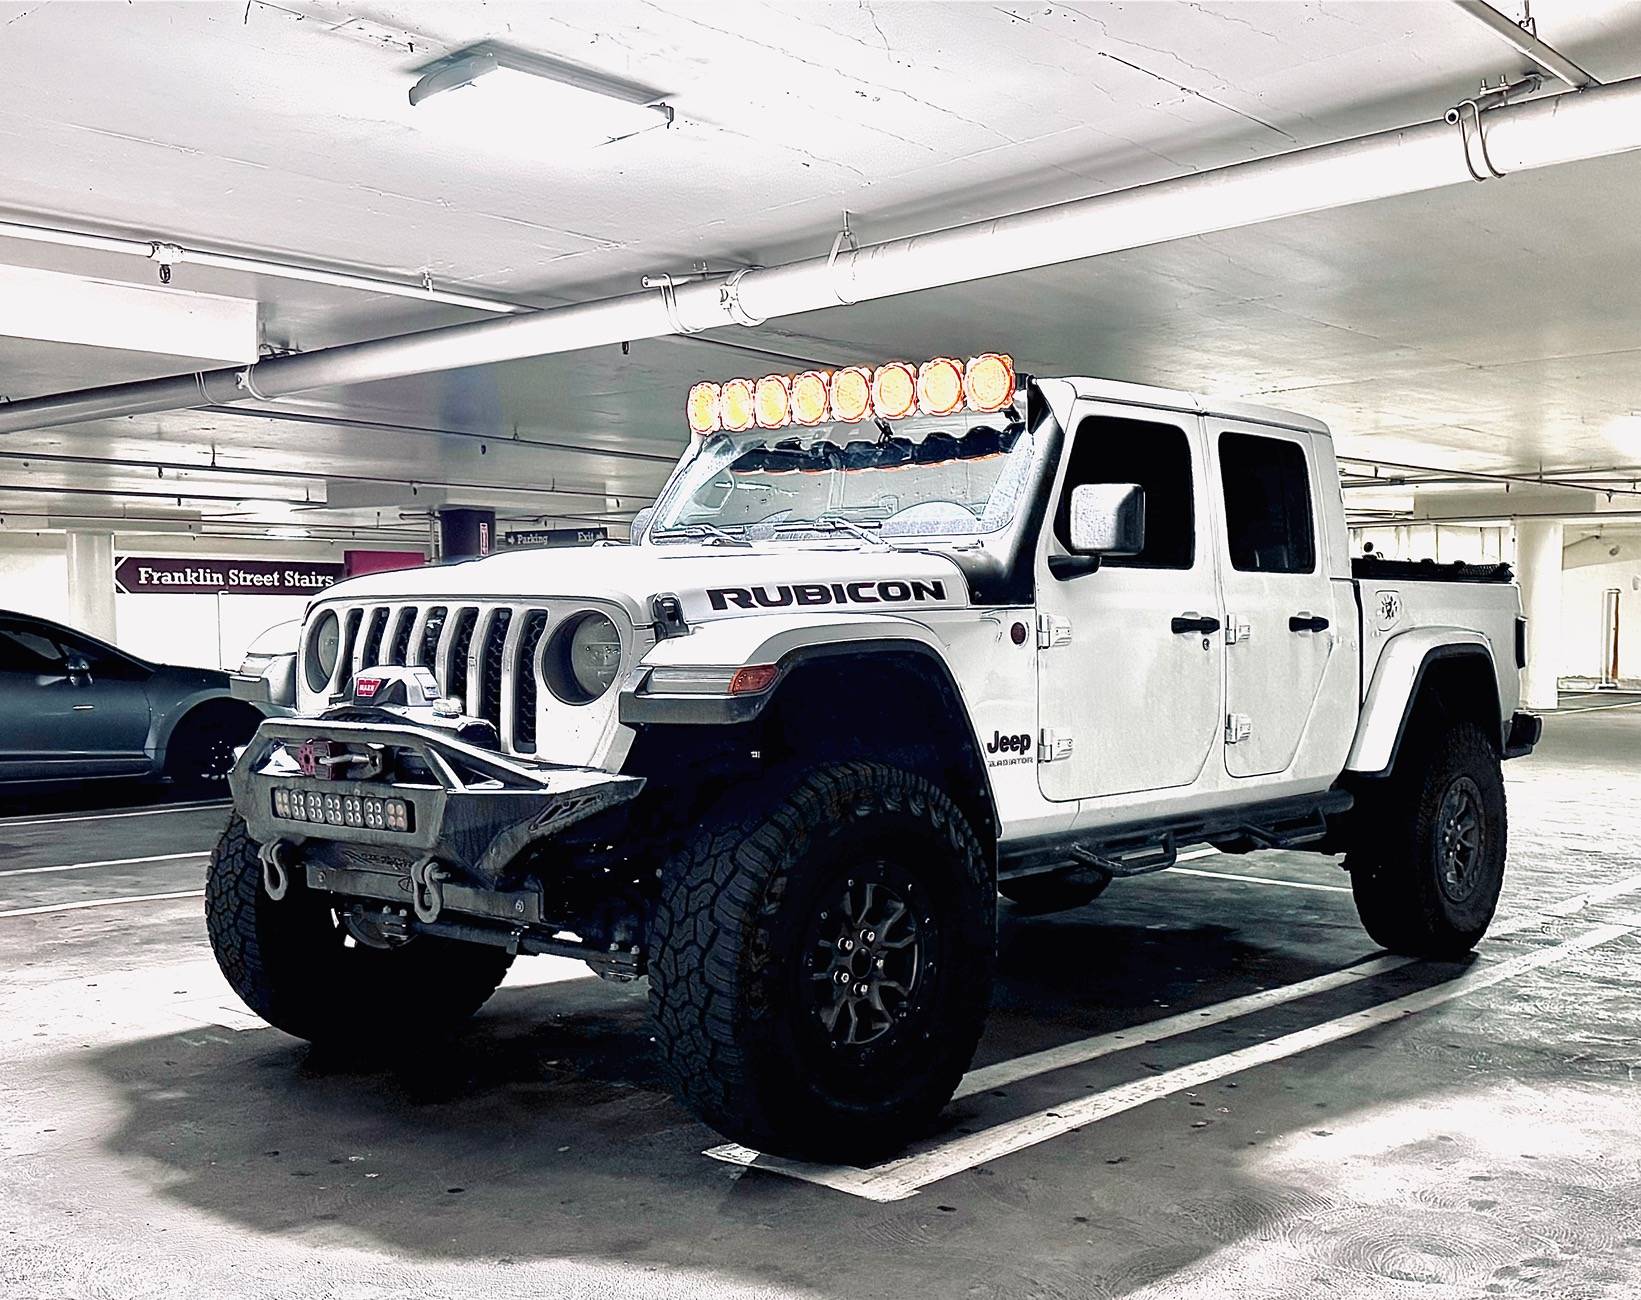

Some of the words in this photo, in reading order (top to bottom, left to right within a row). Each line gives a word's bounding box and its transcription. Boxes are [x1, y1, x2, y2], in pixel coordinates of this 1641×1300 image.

[517, 534, 548, 545] Parking
[577, 531, 594, 542] Exit
[138, 567, 224, 586] Franklin
[228, 569, 280, 587] Street
[284, 571, 334, 588] Stairs
[706, 580, 947, 611] RUBICON
[987, 730, 1031, 755] Jeep
